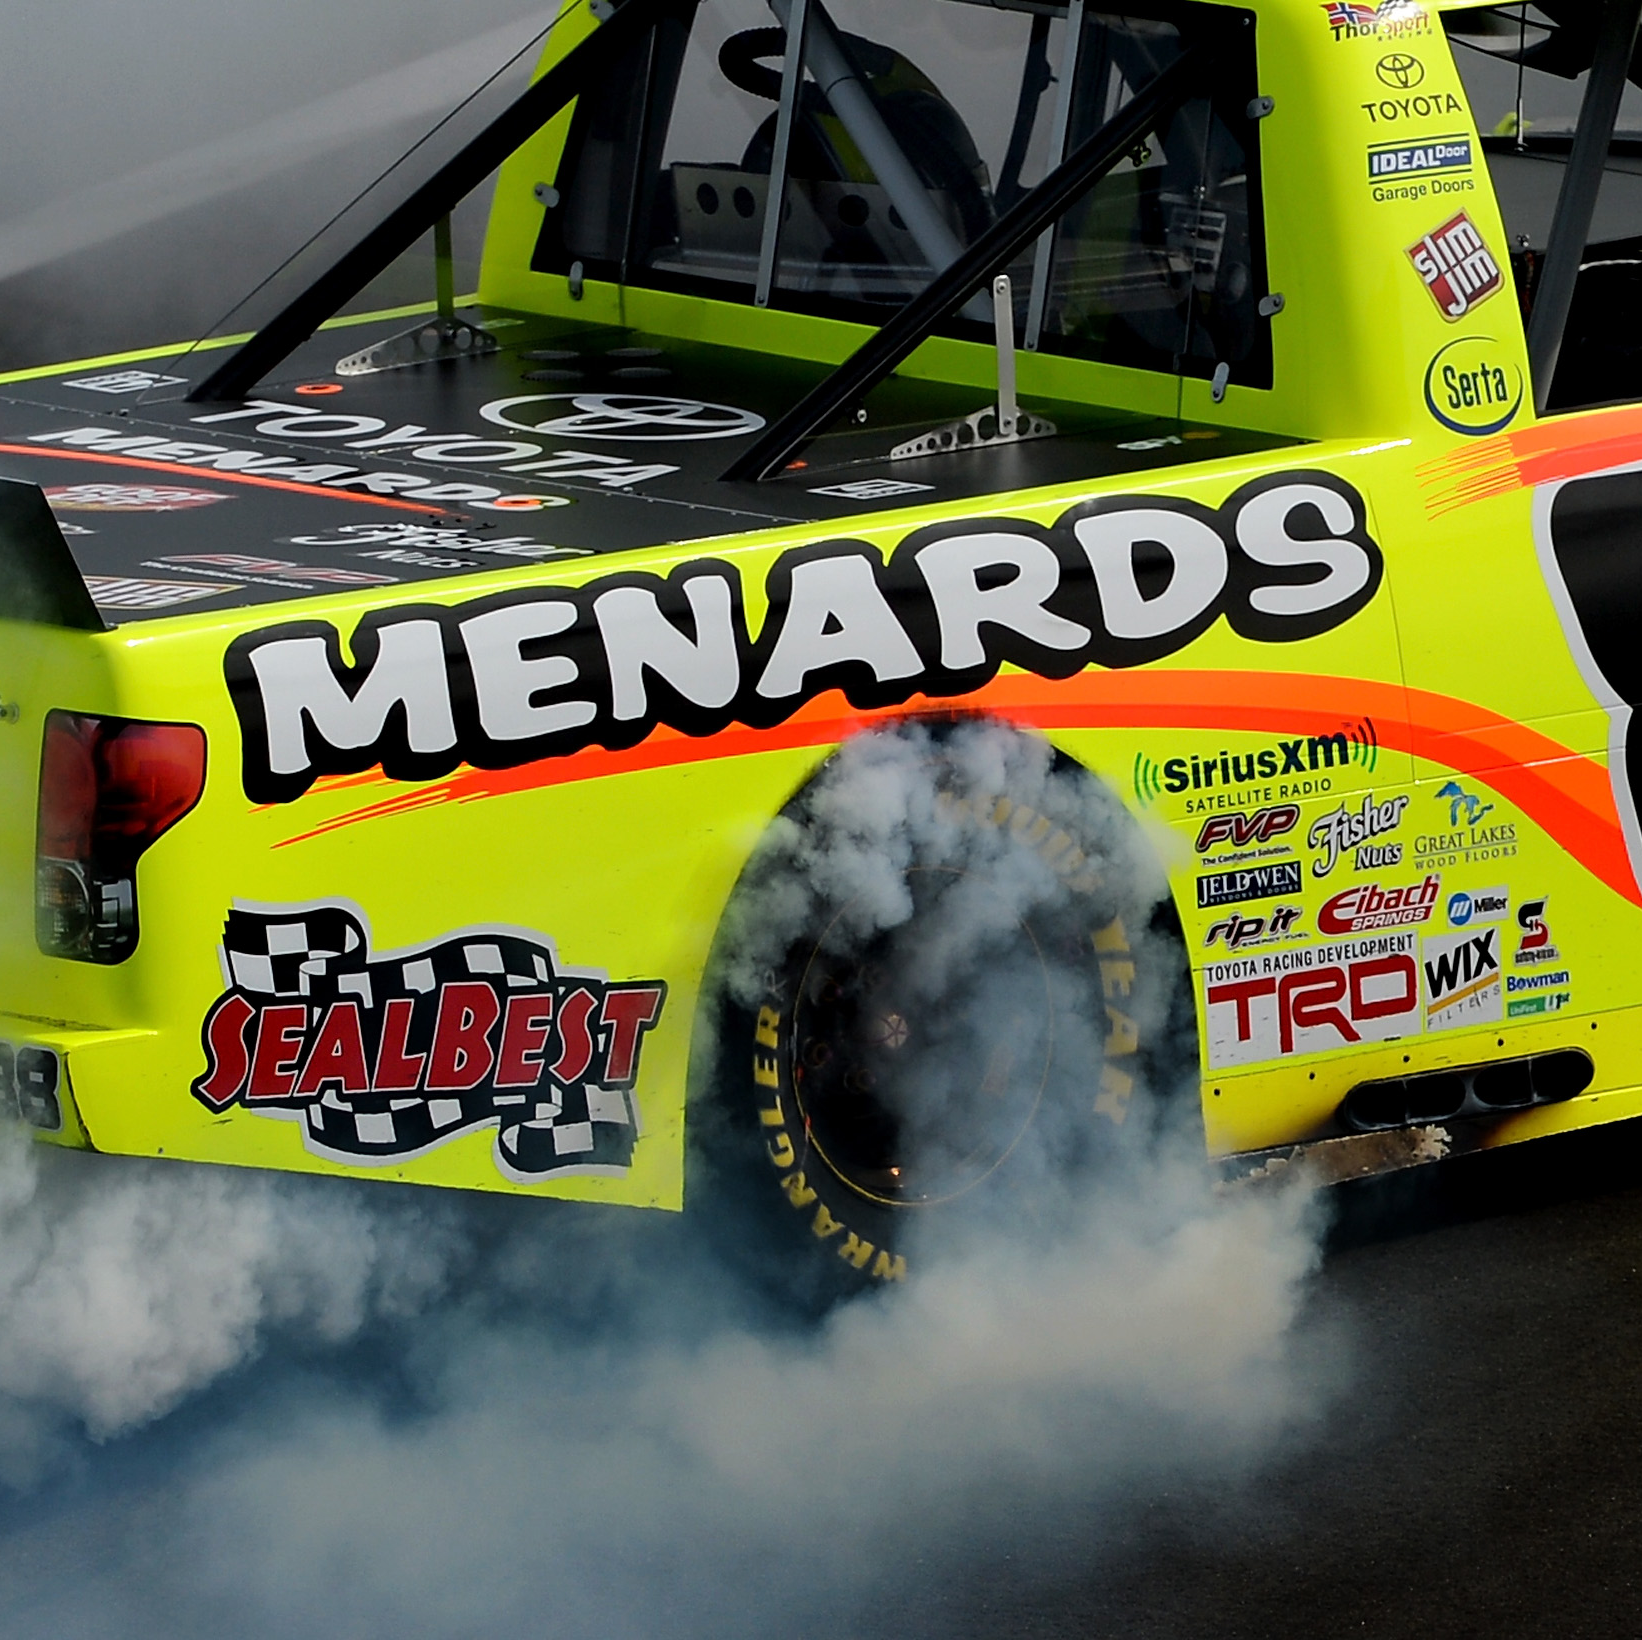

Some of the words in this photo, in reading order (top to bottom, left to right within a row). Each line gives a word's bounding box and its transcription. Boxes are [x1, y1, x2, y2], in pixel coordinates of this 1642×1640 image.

[1362, 93, 1462, 122] TOYOTA
[1372, 149, 1441, 174] IDEAL
[1436, 145, 1468, 160] Door
[1373, 183, 1427, 202] Garage
[1431, 179, 1474, 196] Doors
[1442, 362, 1508, 409] Serta
[190, 400, 682, 488] TOYOTA
[28, 427, 571, 511] MENARDS
[237, 478, 1375, 790] MENARDS
[1186, 787, 1272, 813] SATELLITE
[1280, 778, 1332, 799] RADIO
[1196, 804, 1300, 853] FVP
[1308, 794, 1409, 878] Fisher
[1414, 831, 1464, 854] GREAT
[1471, 824, 1516, 845] LAKES
[1355, 842, 1403, 872] Nuts
[1415, 855, 1456, 870] WOOD
[1465, 845, 1517, 863] FLOORS
[1209, 891, 1253, 905] WINDOWS
[1318, 875, 1440, 928] Eibach
[1350, 907, 1427, 933] SPRINGS
[1473, 897, 1508, 915] Miller
[1205, 913, 1264, 950] rip
[1269, 905, 1302, 935] it
[1208, 960, 1257, 982] TOYOTA
[1263, 951, 1312, 973] RACING
[1318, 934, 1413, 962] DEVELOPMENT
[1424, 929, 1498, 999] WIX
[1208, 954, 1417, 1054] TRD
[1507, 970, 1570, 993] Bowman
[1427, 984, 1501, 1029] FILTERS
[195, 980, 665, 1108] SEALBEST
[753, 1005, 907, 1282] WRANGLER
